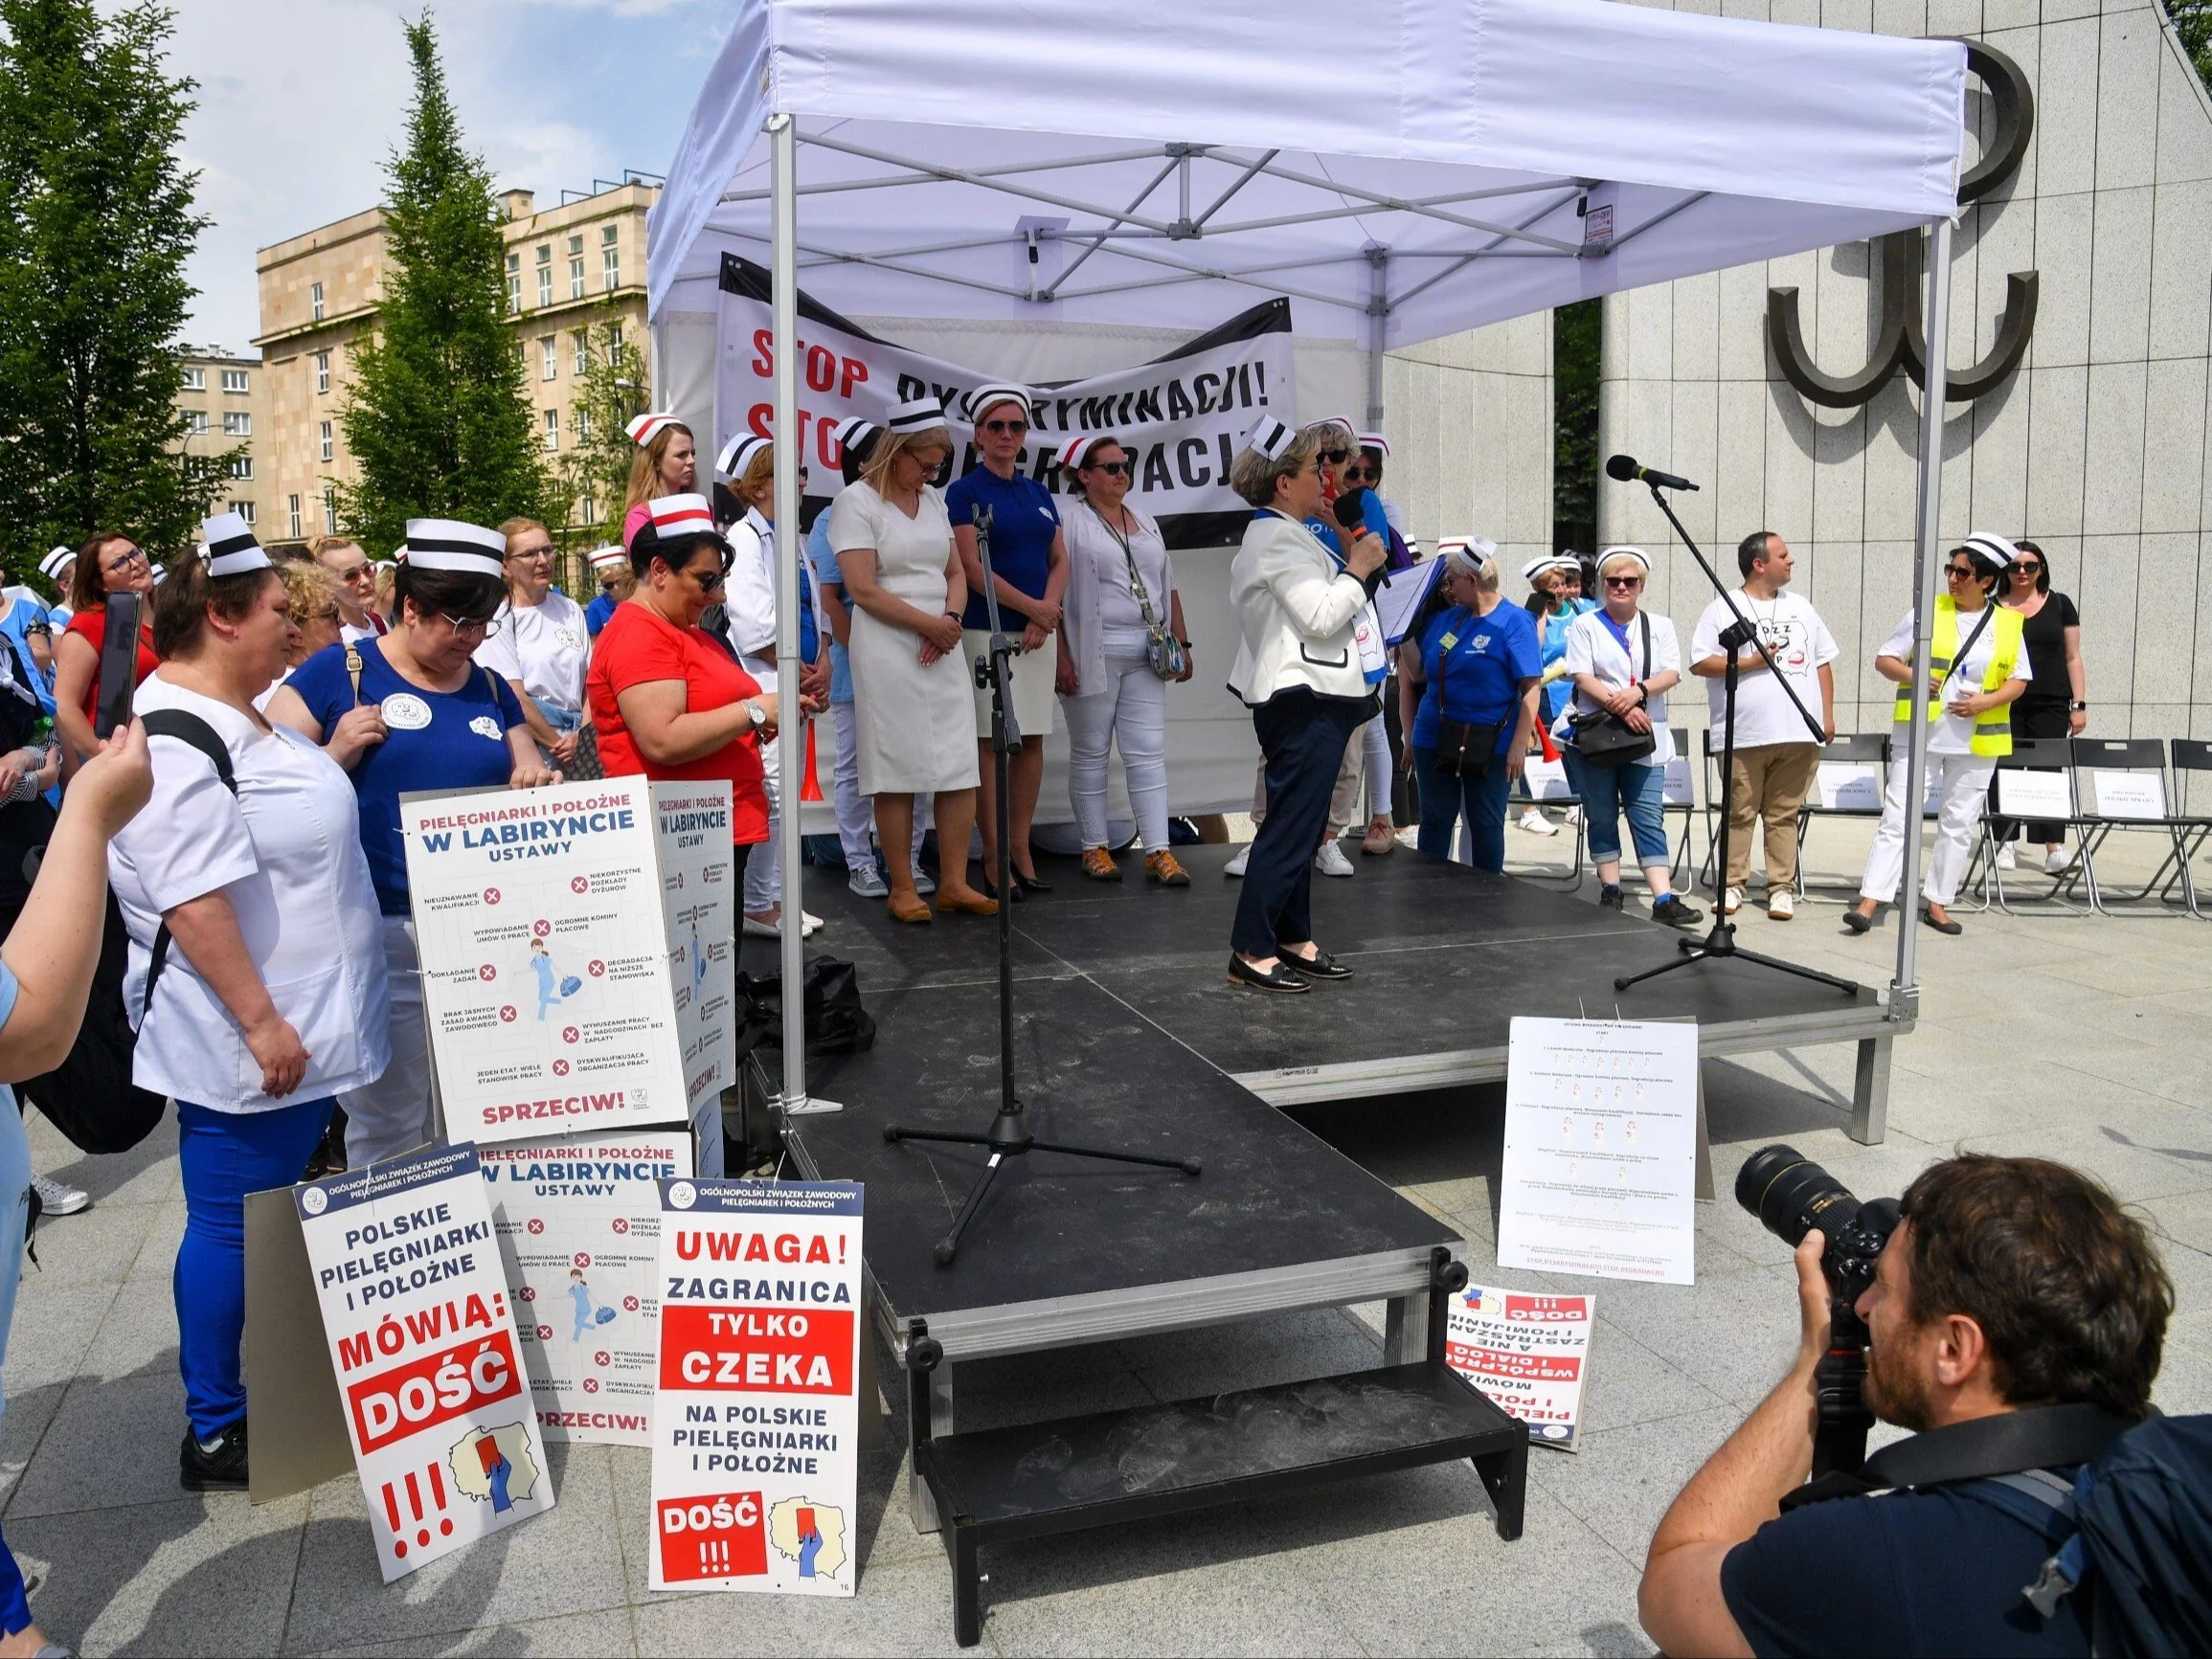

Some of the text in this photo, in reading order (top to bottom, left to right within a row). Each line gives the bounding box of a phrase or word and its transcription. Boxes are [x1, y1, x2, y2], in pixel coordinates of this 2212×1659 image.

[752, 328, 869, 398] SOP
[696, 794, 725, 808] POŁOŻNE
[420, 794, 631, 831] PIELĘGNIARKI I POŁOŻNE
[660, 811, 726, 835] W LABIRYNCIE
[422, 810, 635, 853] W LABIRYNCIE
[678, 834, 704, 848] USTAWY
[489, 841, 572, 862] USTAWY
[590, 867, 642, 879] NIEKORZYSTNE
[591, 877, 627, 886] ROZKŁADY
[592, 885, 626, 894] DYŻURÓW
[424, 892, 479, 905] NIEUZNAWANIE
[431, 900, 480, 911] KWALIFIKACJI
[554, 912, 618, 926] OGROMNE KOMINY
[474, 925, 530, 936] WYPOWIADANIE
[555, 924, 590, 933] PŁACOWE
[477, 935, 499, 944] UMÓW
[508, 931, 530, 941] PRACĘ
[607, 956, 653, 967] DEGRADACJA
[620, 963, 643, 973] NIŻSZE
[431, 968, 476, 979] DOKŁADANIE
[453, 975, 477, 984] ZADAŃ
[609, 971, 655, 981] STANOWISKA
[443, 1006, 496, 1019] BRAK JASNYCH
[440, 1014, 497, 1026] ZASAD AWANSU
[445, 1020, 498, 1033] ZAWODOWEGO
[582, 1017, 650, 1029] WYMUSZANIE PRACY
[594, 1024, 647, 1036] NADGODZINACH
[584, 1035, 614, 1043] ZAPŁATY
[576, 1052, 644, 1065] DYSKWALIFIKUJĄCA
[577, 1060, 649, 1072] ORGANIZACJA PRACY
[478, 1071, 543, 1085] STANOWISK PRACY
[688, 1065, 715, 1104] SPRZECIW!
[482, 1091, 625, 1125] SPRZECIW!
[481, 1145, 674, 1163] IELĘGNIARKI I POŁOŻNE
[328, 1150, 471, 1196] OGÓLNOPOLSKI ZWIĄZEK ZAWODOWY
[510, 1162, 676, 1181] LABIRYNCIE
[350, 1178, 403, 1199] PIELĘGNIAREK
[407, 1164, 454, 1183] POŁOŻNYCH
[535, 1184, 616, 1197] USTAWY
[700, 1186, 857, 1200] OGÓLNOPOLSKI ZWIĄZEK ZAWODOWY
[721, 1198, 779, 1208] PIELĘGNIAREK
[784, 1199, 835, 1209] POŁOŻNYCH
[346, 1203, 452, 1250] POLSKIE
[320, 1221, 490, 1289] PIELĘGNIARKI
[677, 1231, 846, 1265] UWAGA!
[346, 1253, 476, 1312] I POŁOŻNE
[667, 1277, 851, 1303] ZAGRANICA
[1510, 1310, 1583, 1321] DOŚĆ
[338, 1292, 506, 1372] MÓWIĄ:
[708, 1312, 809, 1338] TYLKO
[1477, 1337, 1510, 1350] NIE
[682, 1350, 833, 1387] CZEKA
[360, 1341, 508, 1441] DOŚĆ
[606, 1387, 651, 1396] ORGANIZACJA
[686, 1405, 827, 1426] NA POLSKIE
[1503, 1405, 1570, 1420] PIELĘ
[673, 1429, 837, 1451] PIELĘGNIARKI
[692, 1452, 818, 1474] I POŁOŻNE
[382, 1462, 454, 1558] !!!
[664, 1495, 757, 1534] DOŚĆ
[699, 1540, 731, 1574] !!!
